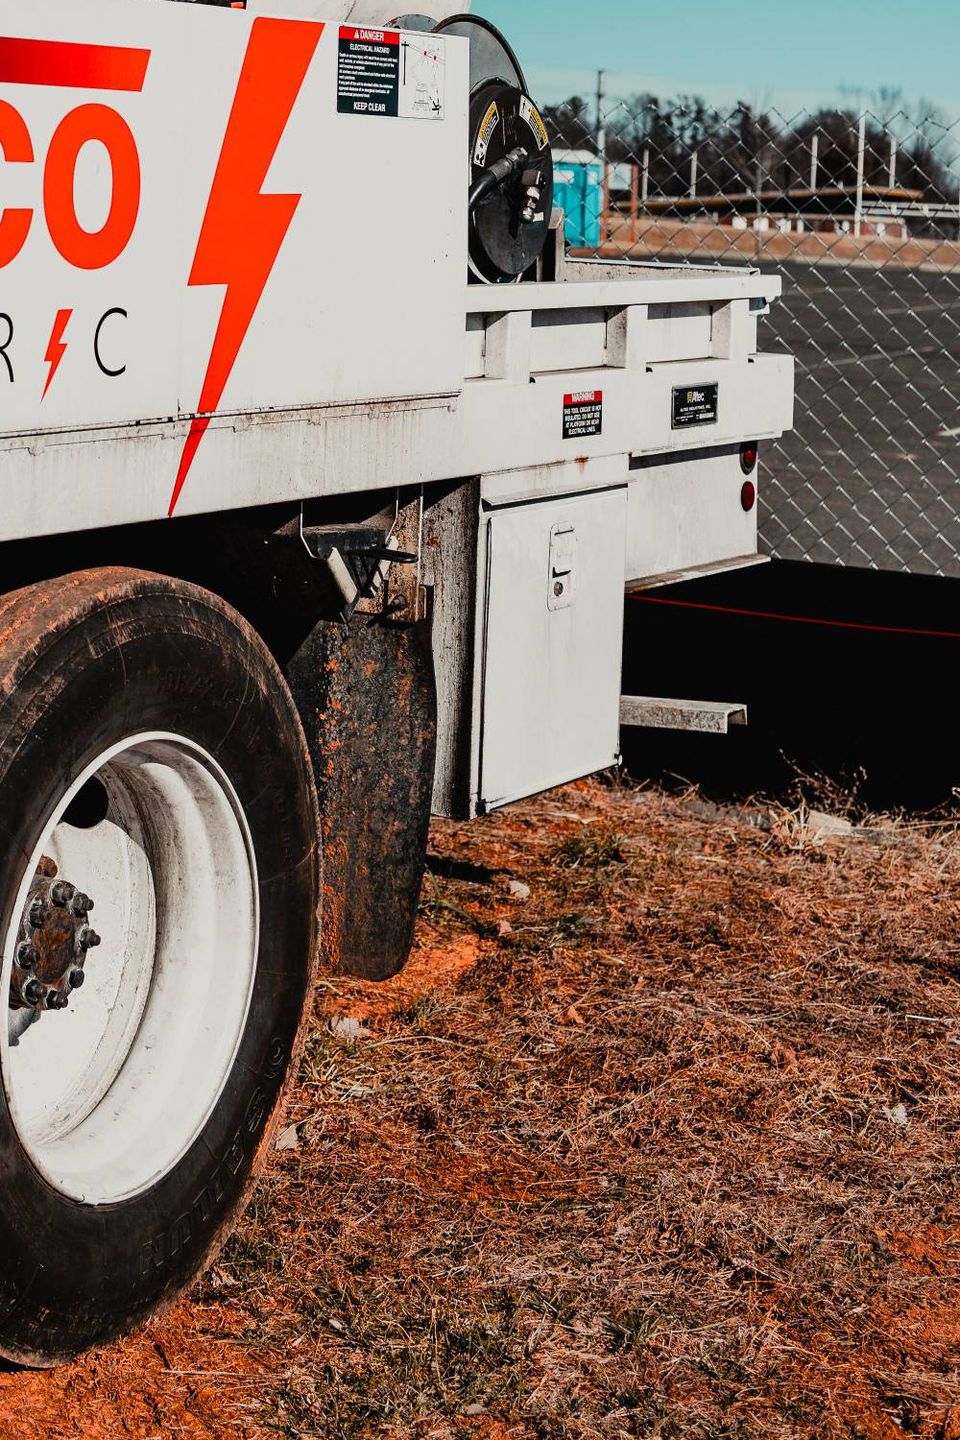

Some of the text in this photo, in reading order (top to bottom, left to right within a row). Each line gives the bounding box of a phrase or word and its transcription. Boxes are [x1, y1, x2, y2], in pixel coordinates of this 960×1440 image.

[360, 29, 385, 42] DANGER
[353, 101, 386, 112] KEEP CLEAR
